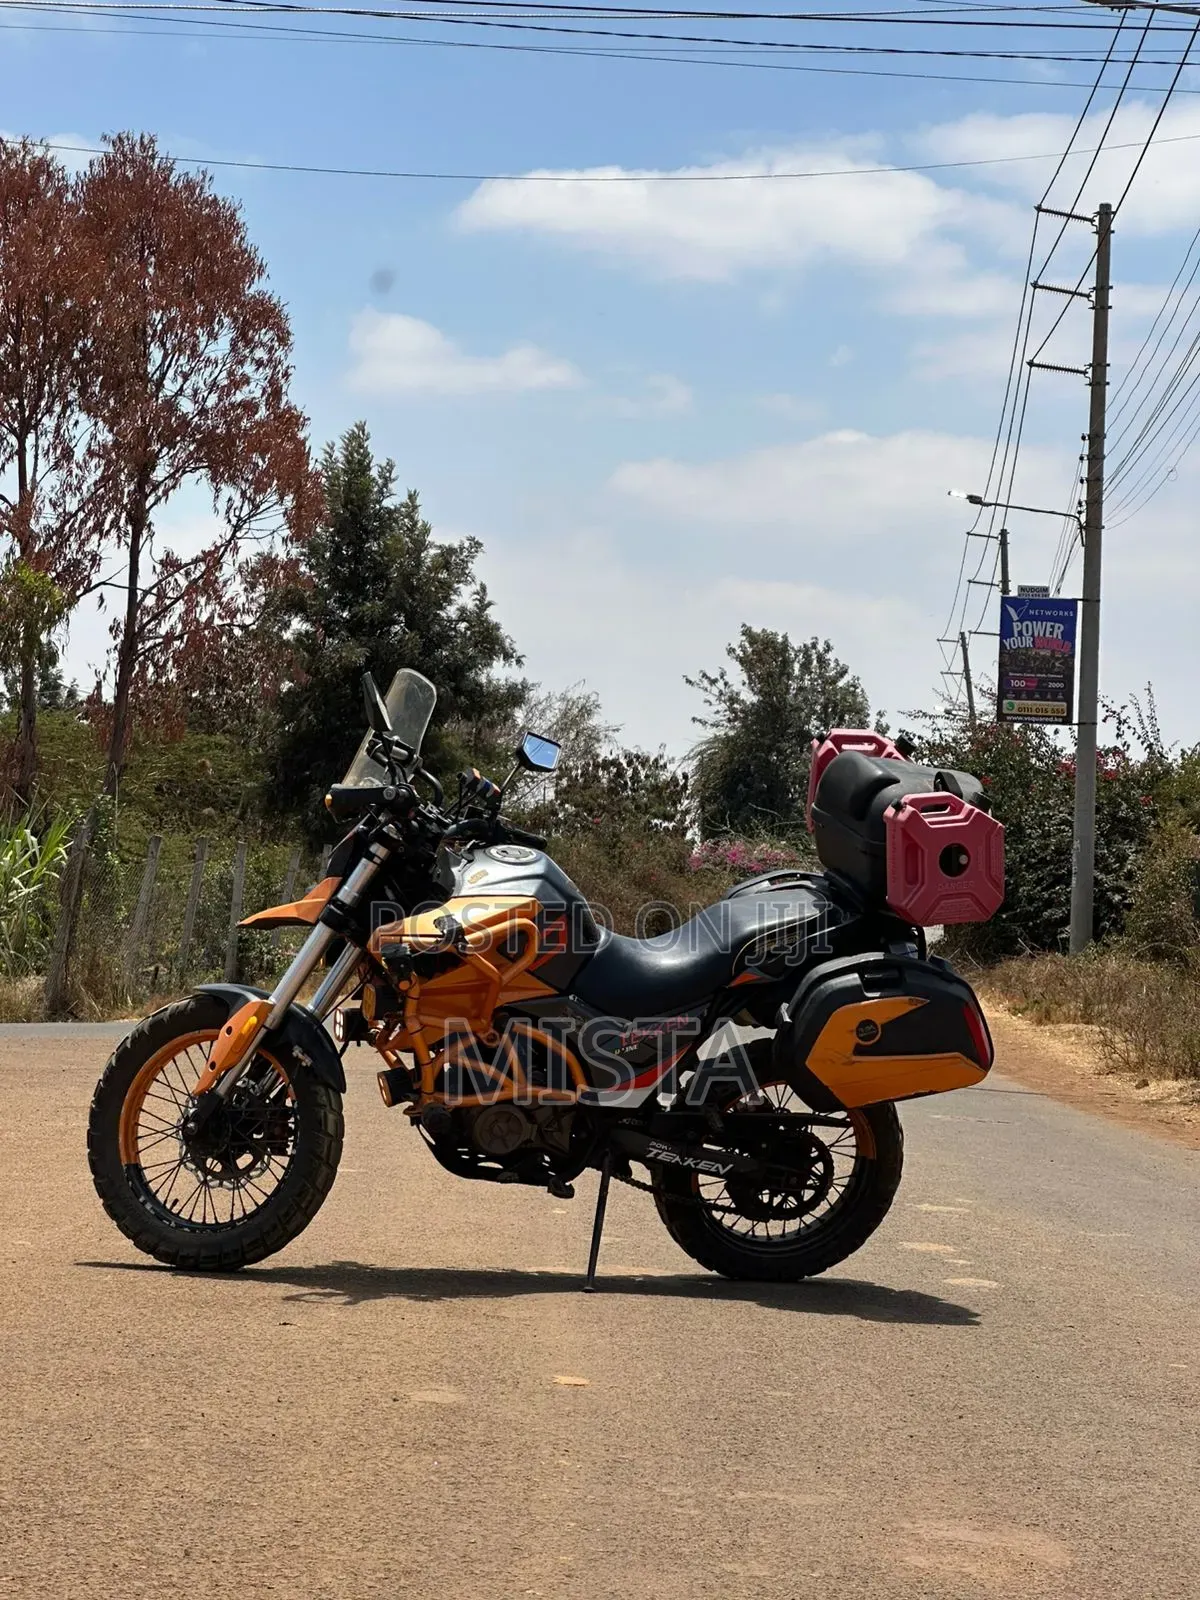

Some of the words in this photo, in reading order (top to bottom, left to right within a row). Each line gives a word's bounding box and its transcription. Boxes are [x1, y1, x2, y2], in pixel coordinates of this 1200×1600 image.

[1029, 609, 1074, 617] NETWORKS
[1012, 620, 1064, 639] POWER
[1003, 636, 1033, 650] YOUR
[1010, 679, 1026, 687] 100
[645, 1147, 735, 1175] TEKKEN
